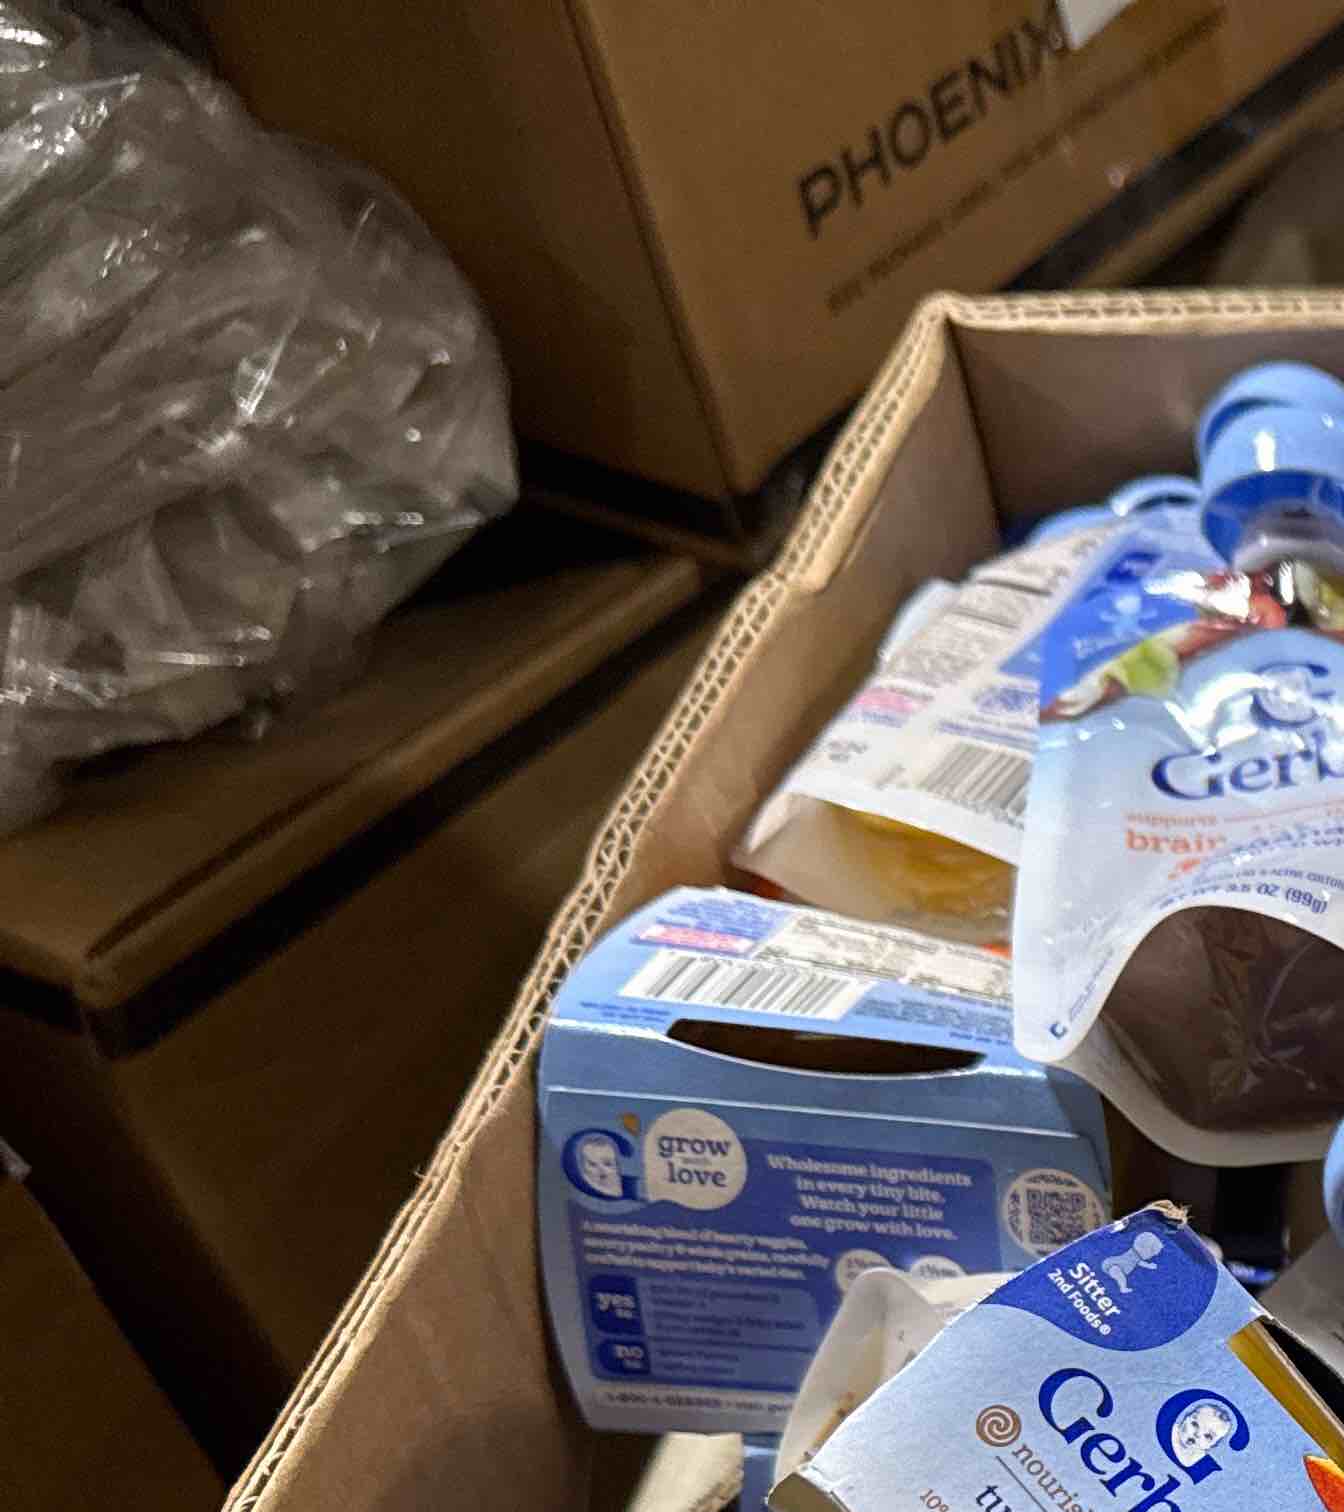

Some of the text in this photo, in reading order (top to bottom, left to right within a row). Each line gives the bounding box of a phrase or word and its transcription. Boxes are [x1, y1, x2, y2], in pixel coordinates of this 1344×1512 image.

[794, 14, 1074, 241] PHOENIX
[658, 1135, 731, 1158] grow
[665, 1164, 727, 1189] love
[1047, 1266, 1075, 1296] 2nd
[1065, 1262, 1121, 1319] Sitter
